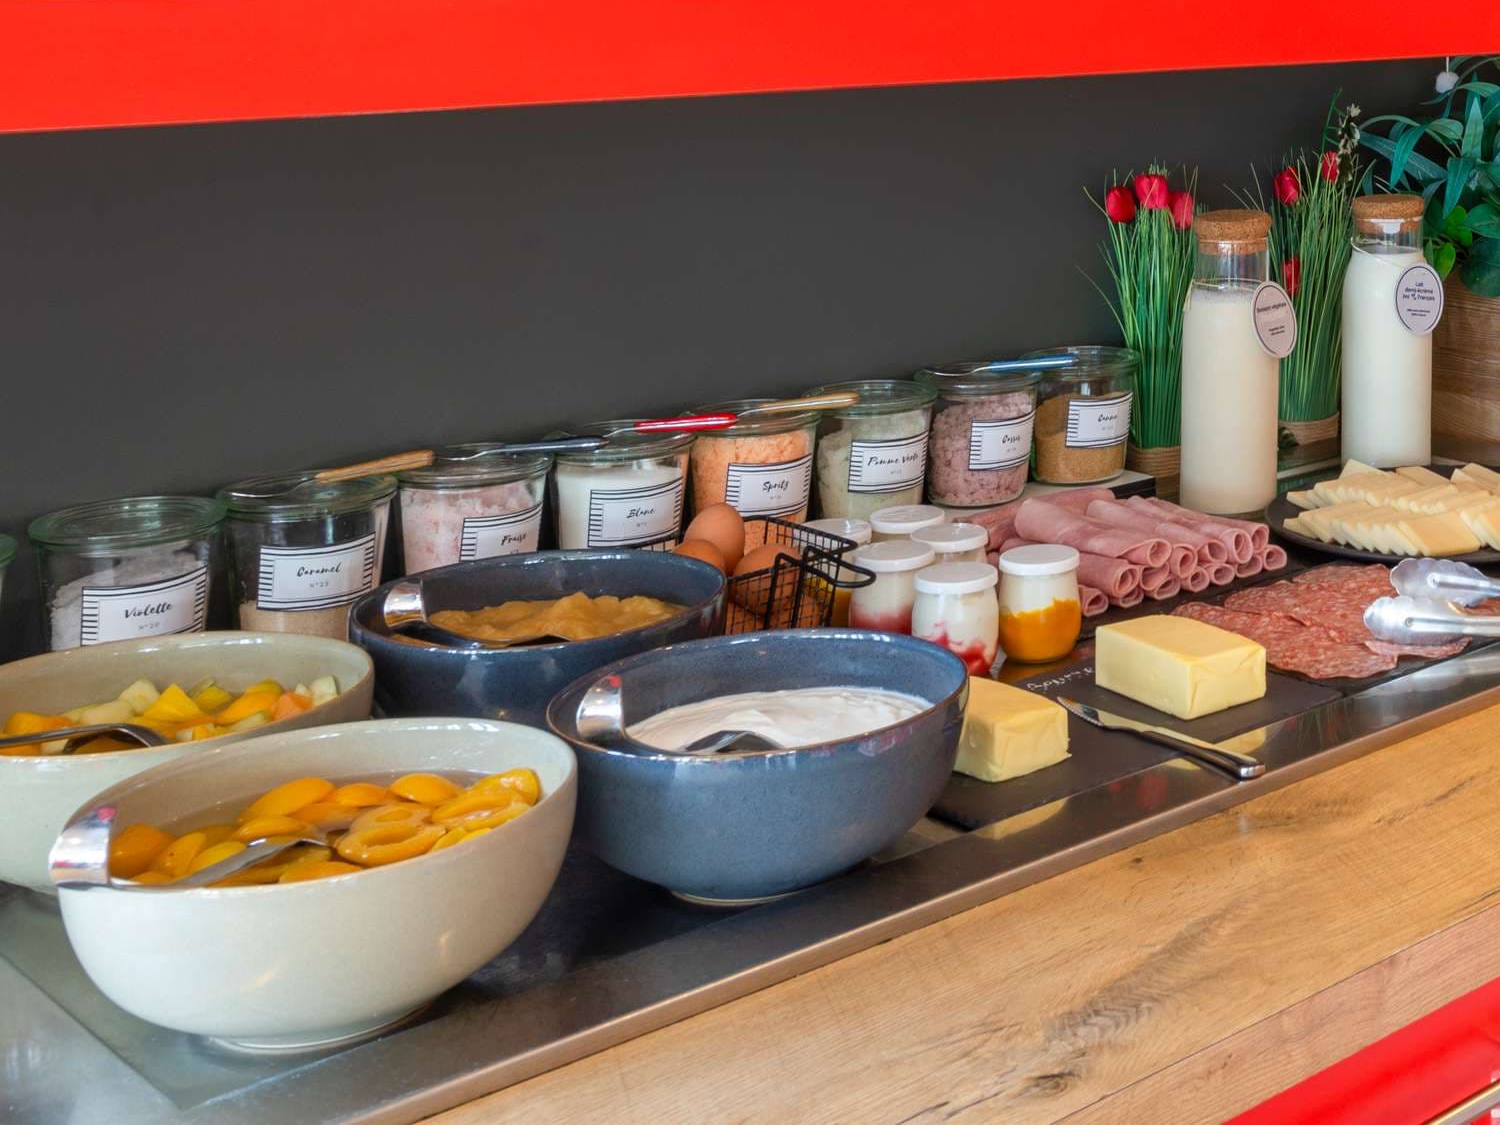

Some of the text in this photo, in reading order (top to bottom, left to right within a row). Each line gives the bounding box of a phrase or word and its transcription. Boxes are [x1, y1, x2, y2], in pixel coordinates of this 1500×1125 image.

[867, 456, 899, 467] Pomme
[296, 562, 343, 578] Caramel
[124, 602, 174, 619] Violette
